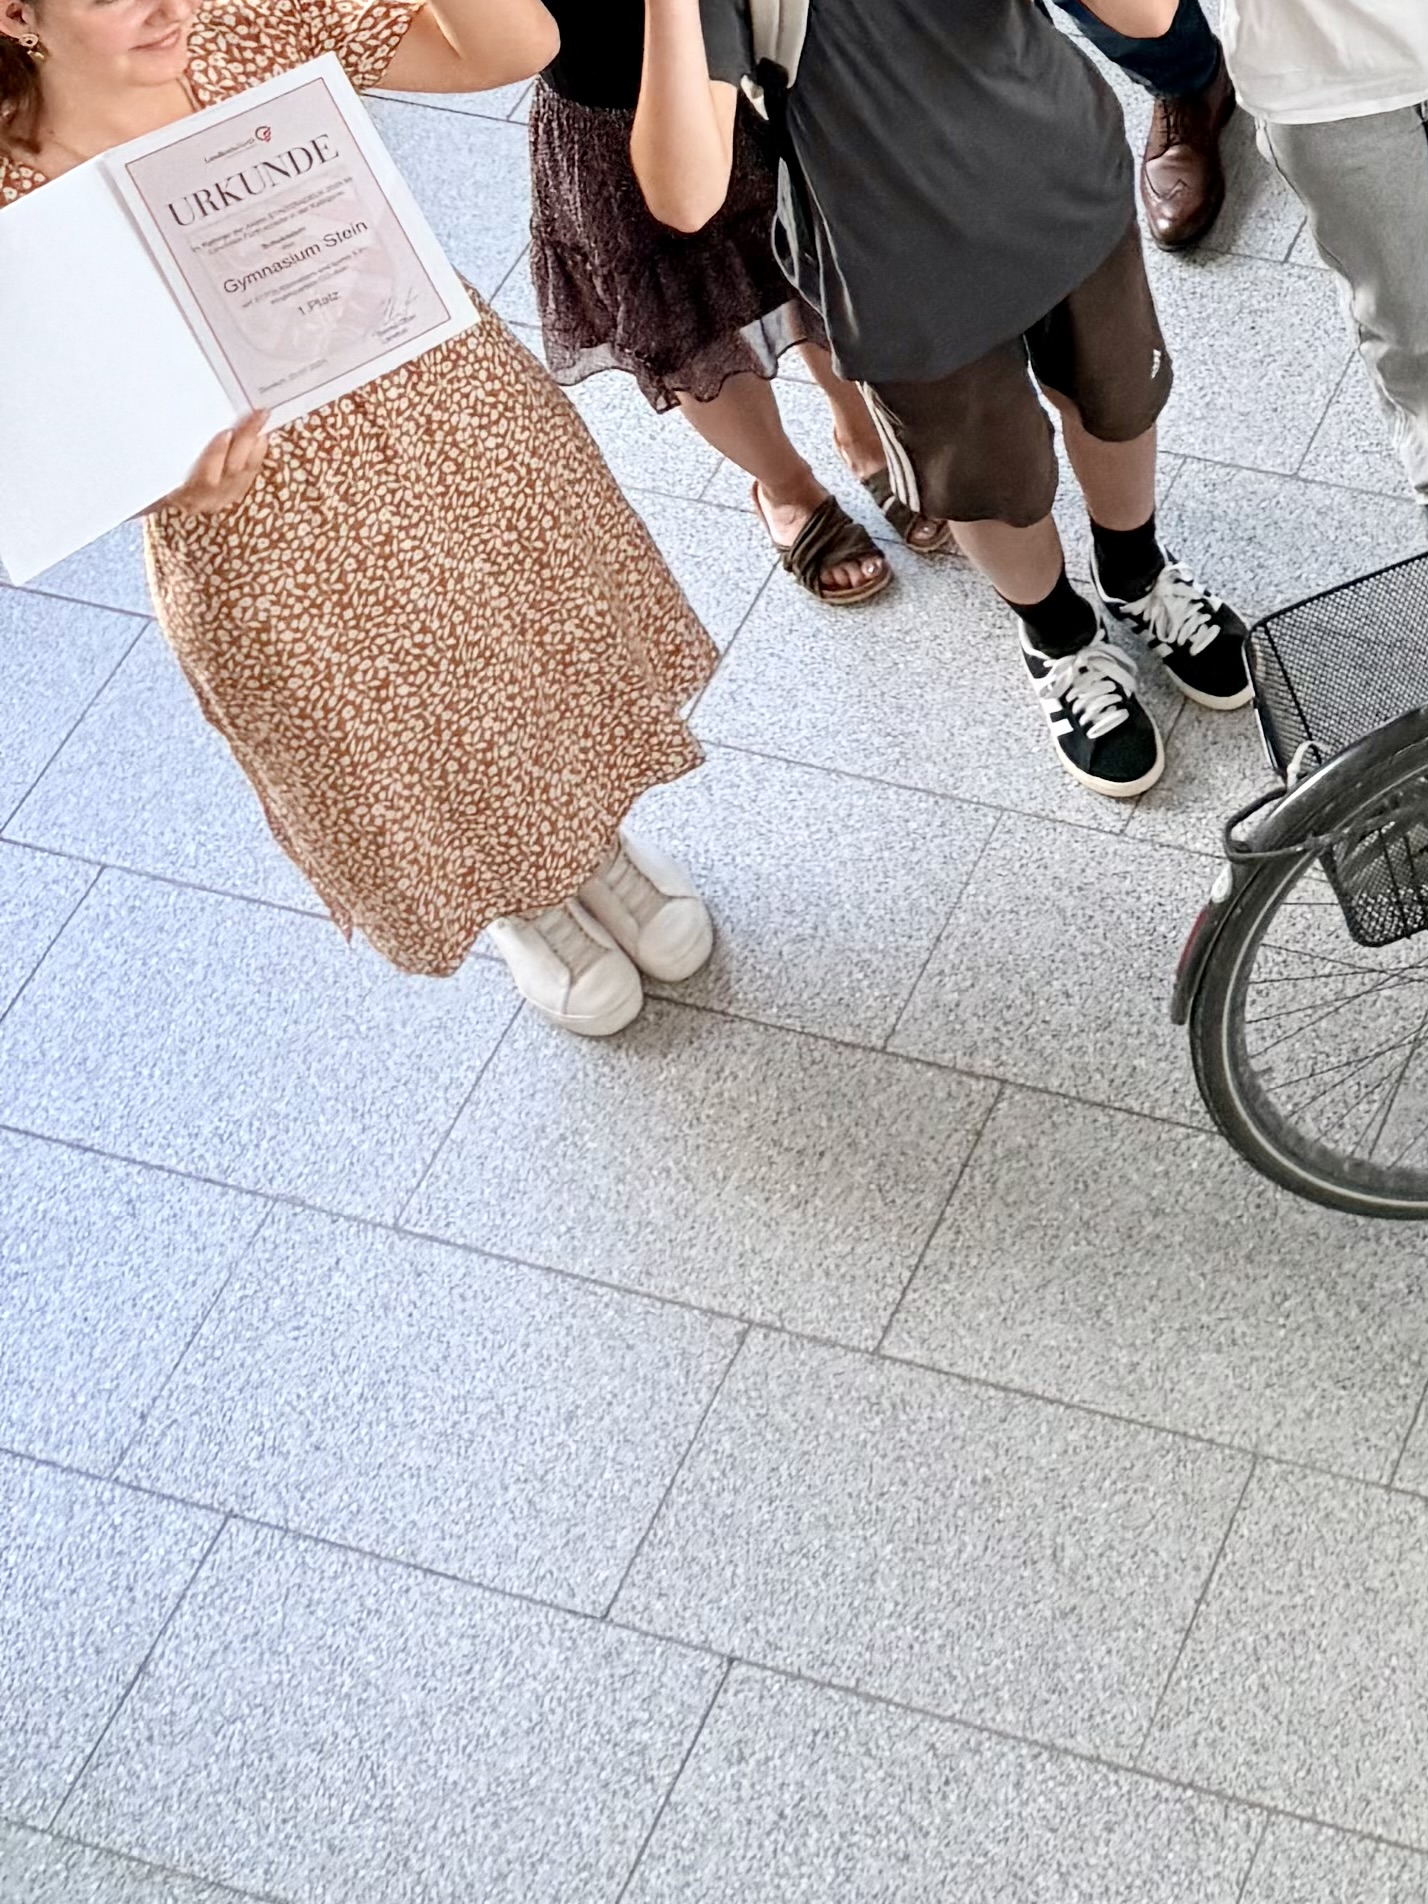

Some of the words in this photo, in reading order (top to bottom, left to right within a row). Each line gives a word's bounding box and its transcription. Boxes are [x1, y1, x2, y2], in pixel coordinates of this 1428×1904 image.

[164, 132, 340, 228] URKUNDE
[223, 243, 322, 294] Gymnasium
[322, 219, 369, 249] Stein
